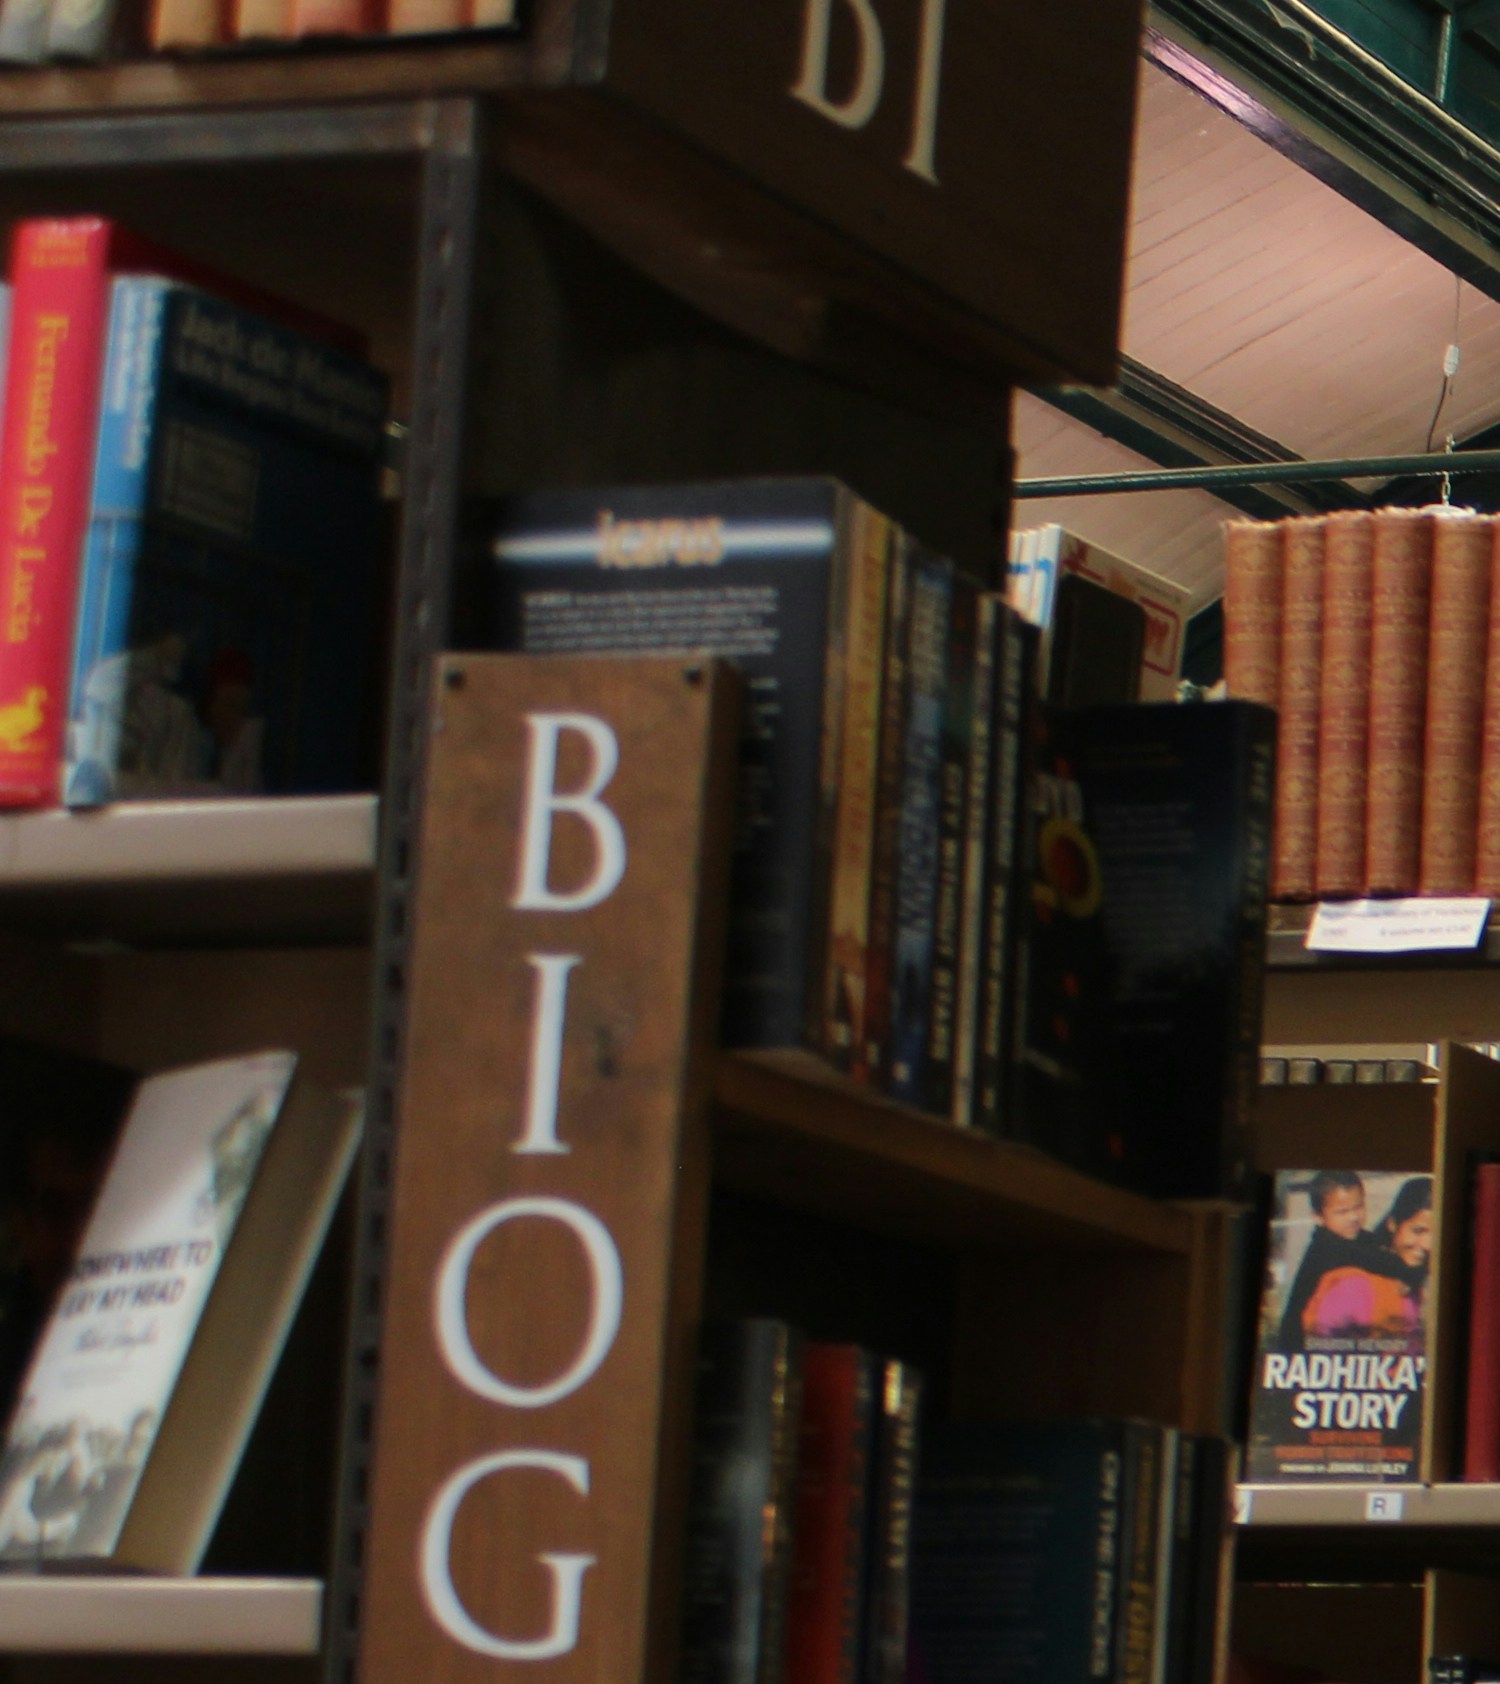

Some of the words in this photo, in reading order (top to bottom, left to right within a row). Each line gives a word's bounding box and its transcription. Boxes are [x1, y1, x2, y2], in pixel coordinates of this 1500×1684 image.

[26, 313, 70, 475] Fernando
[8, 549, 47, 643] Lucia
[1262, 1353, 1427, 1391] RADHIKA'
[1290, 1392, 1408, 1430] STORY
